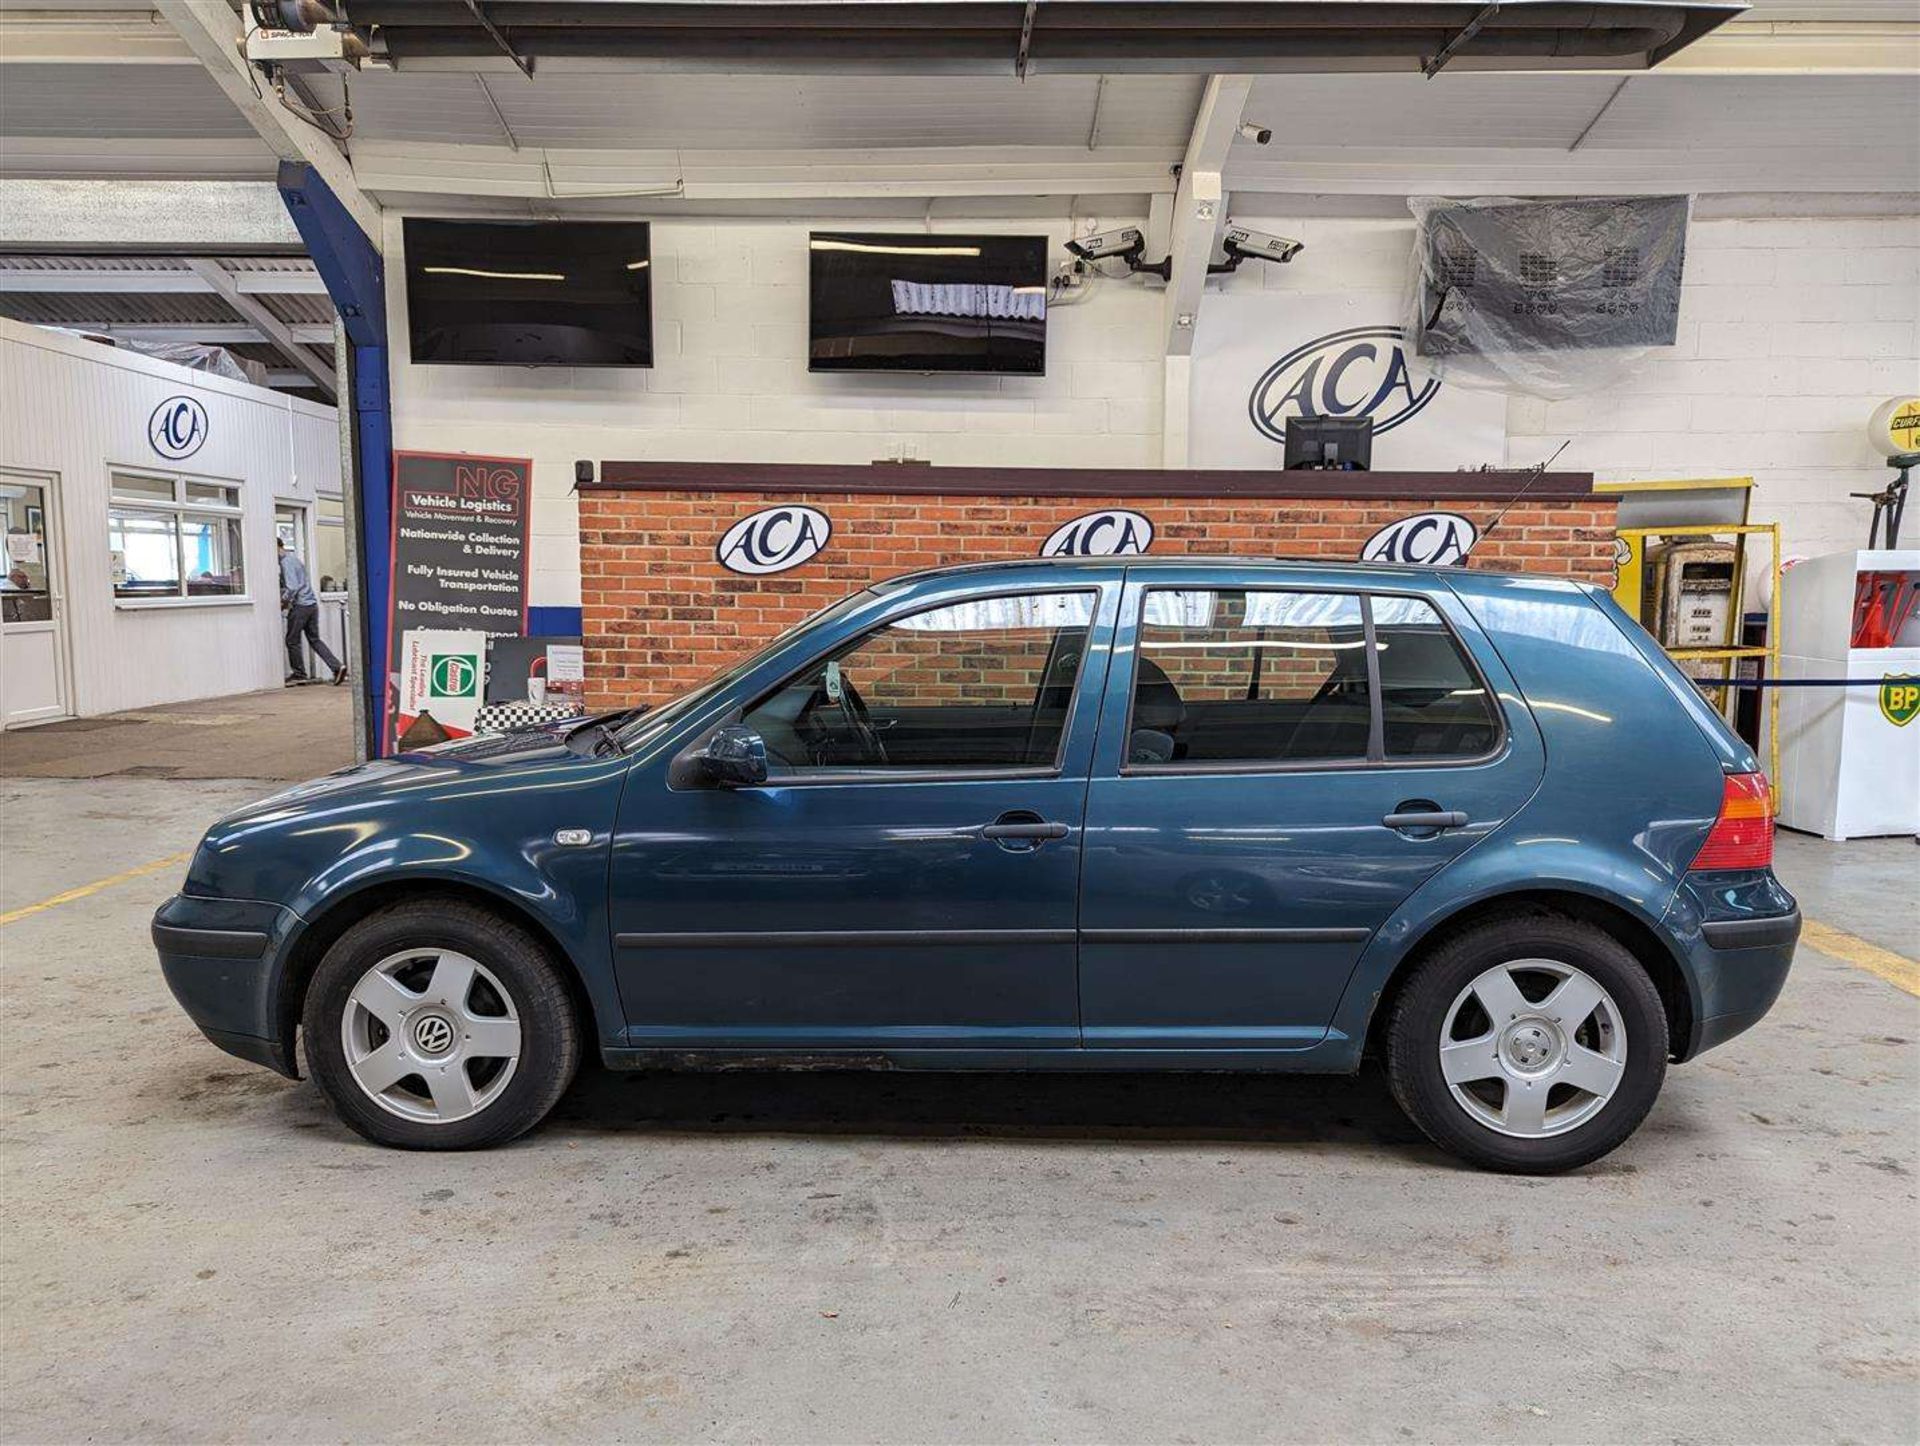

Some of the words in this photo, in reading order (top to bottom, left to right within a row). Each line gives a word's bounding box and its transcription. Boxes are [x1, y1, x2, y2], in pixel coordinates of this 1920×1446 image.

[1262, 343, 1419, 418] ACA
[154, 402, 203, 450] ACA
[1892, 416, 1920, 429] CURF
[456, 466, 519, 499] NG
[412, 494, 457, 508] Vehicle
[460, 497, 513, 512] Logistics
[405, 510, 432, 520] Vehicle
[433, 512, 475, 522] Movement
[476, 515, 483, 523] &
[484, 516, 518, 527] Recovery
[400, 528, 466, 542] Nationwide
[468, 532, 520, 545] Collection
[720, 511, 820, 567] ACA
[1053, 516, 1140, 555] ACA
[1373, 518, 1464, 564] ACA
[463, 544, 472, 554] &
[475, 545, 520, 559] Delivery
[407, 564, 434, 578] Fully
[436, 566, 479, 579] Insured
[481, 569, 519, 581] Vehicle
[439, 578, 519, 593] Transportation
[399, 600, 416, 611] No
[418, 602, 478, 615] Obligation
[480, 604, 519, 617] Quotes
[1888, 686, 1919, 711] BP
